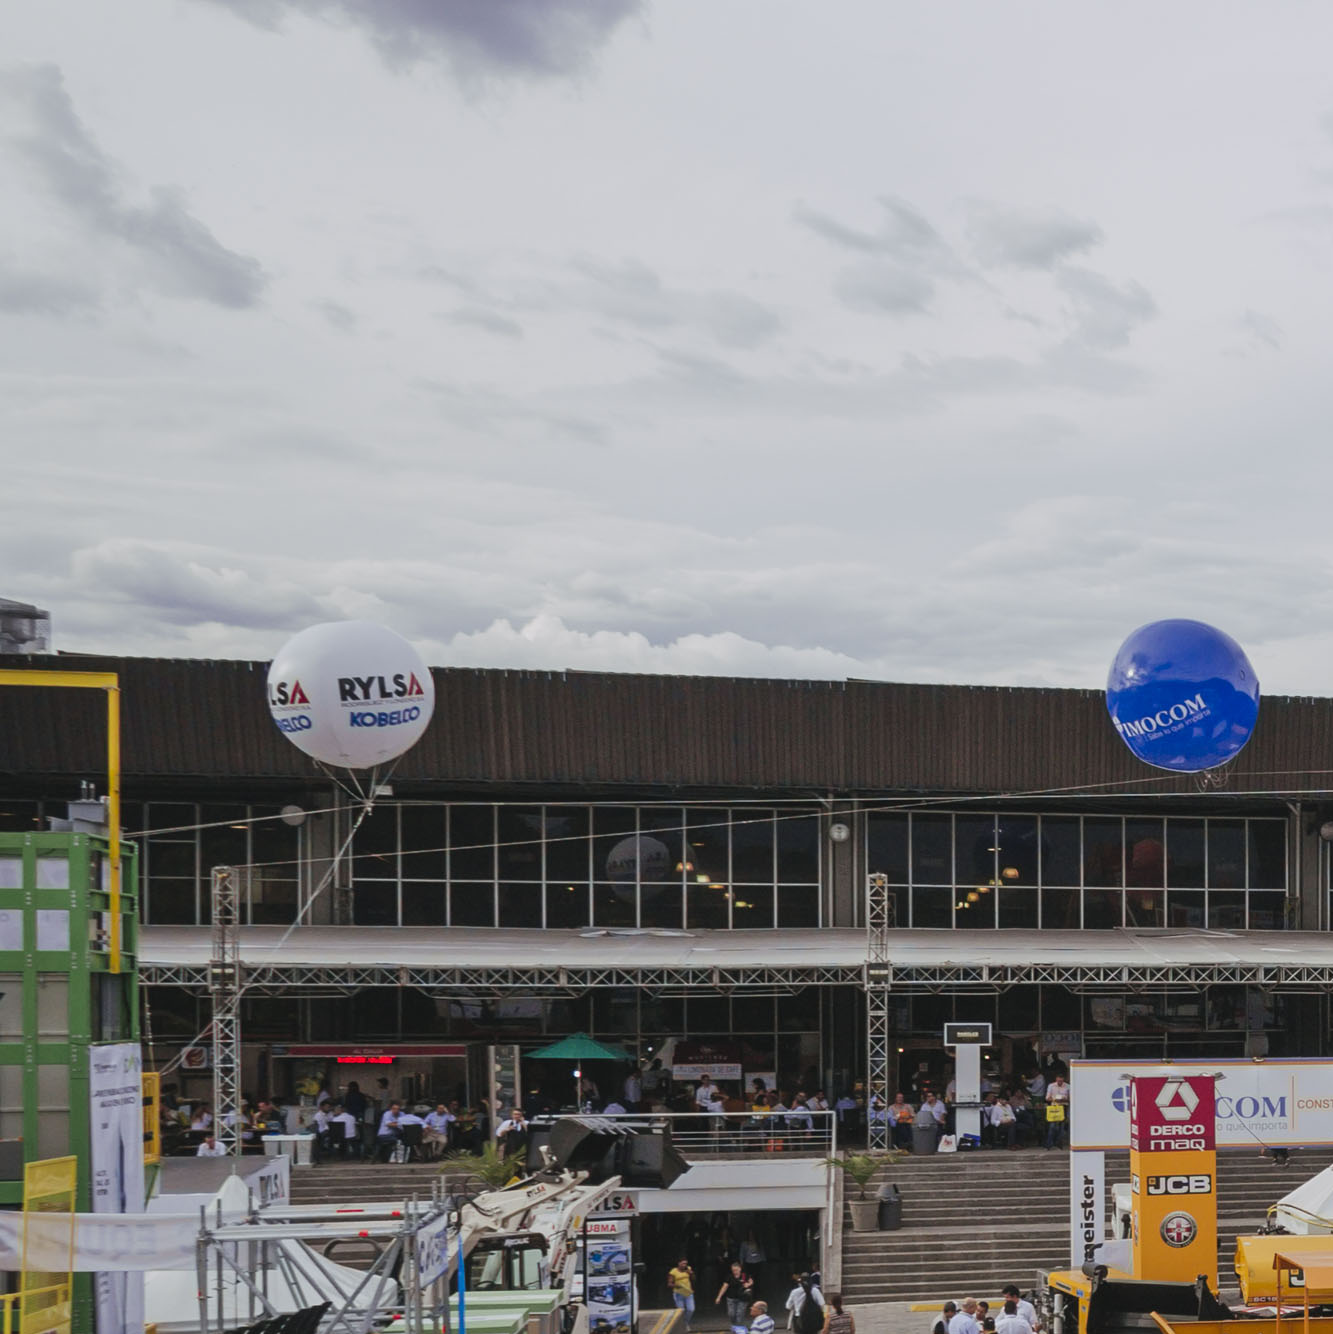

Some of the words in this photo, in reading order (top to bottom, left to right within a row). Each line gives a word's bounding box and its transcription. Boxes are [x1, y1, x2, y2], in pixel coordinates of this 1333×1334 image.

[268, 680, 310, 706] LSA
[338, 672, 424, 702] RYLSA
[350, 706, 421, 728] KOBELCO
[1122, 693, 1207, 738] IMOCOM
[1215, 1096, 1287, 1119] COM
[1150, 1124, 1206, 1136] DERCO
[1245, 1120, 1288, 1132] importa
[1148, 1174, 1212, 1195] JCB
[597, 1195, 635, 1212] LSA
[1081, 1175, 1095, 1262] meister
